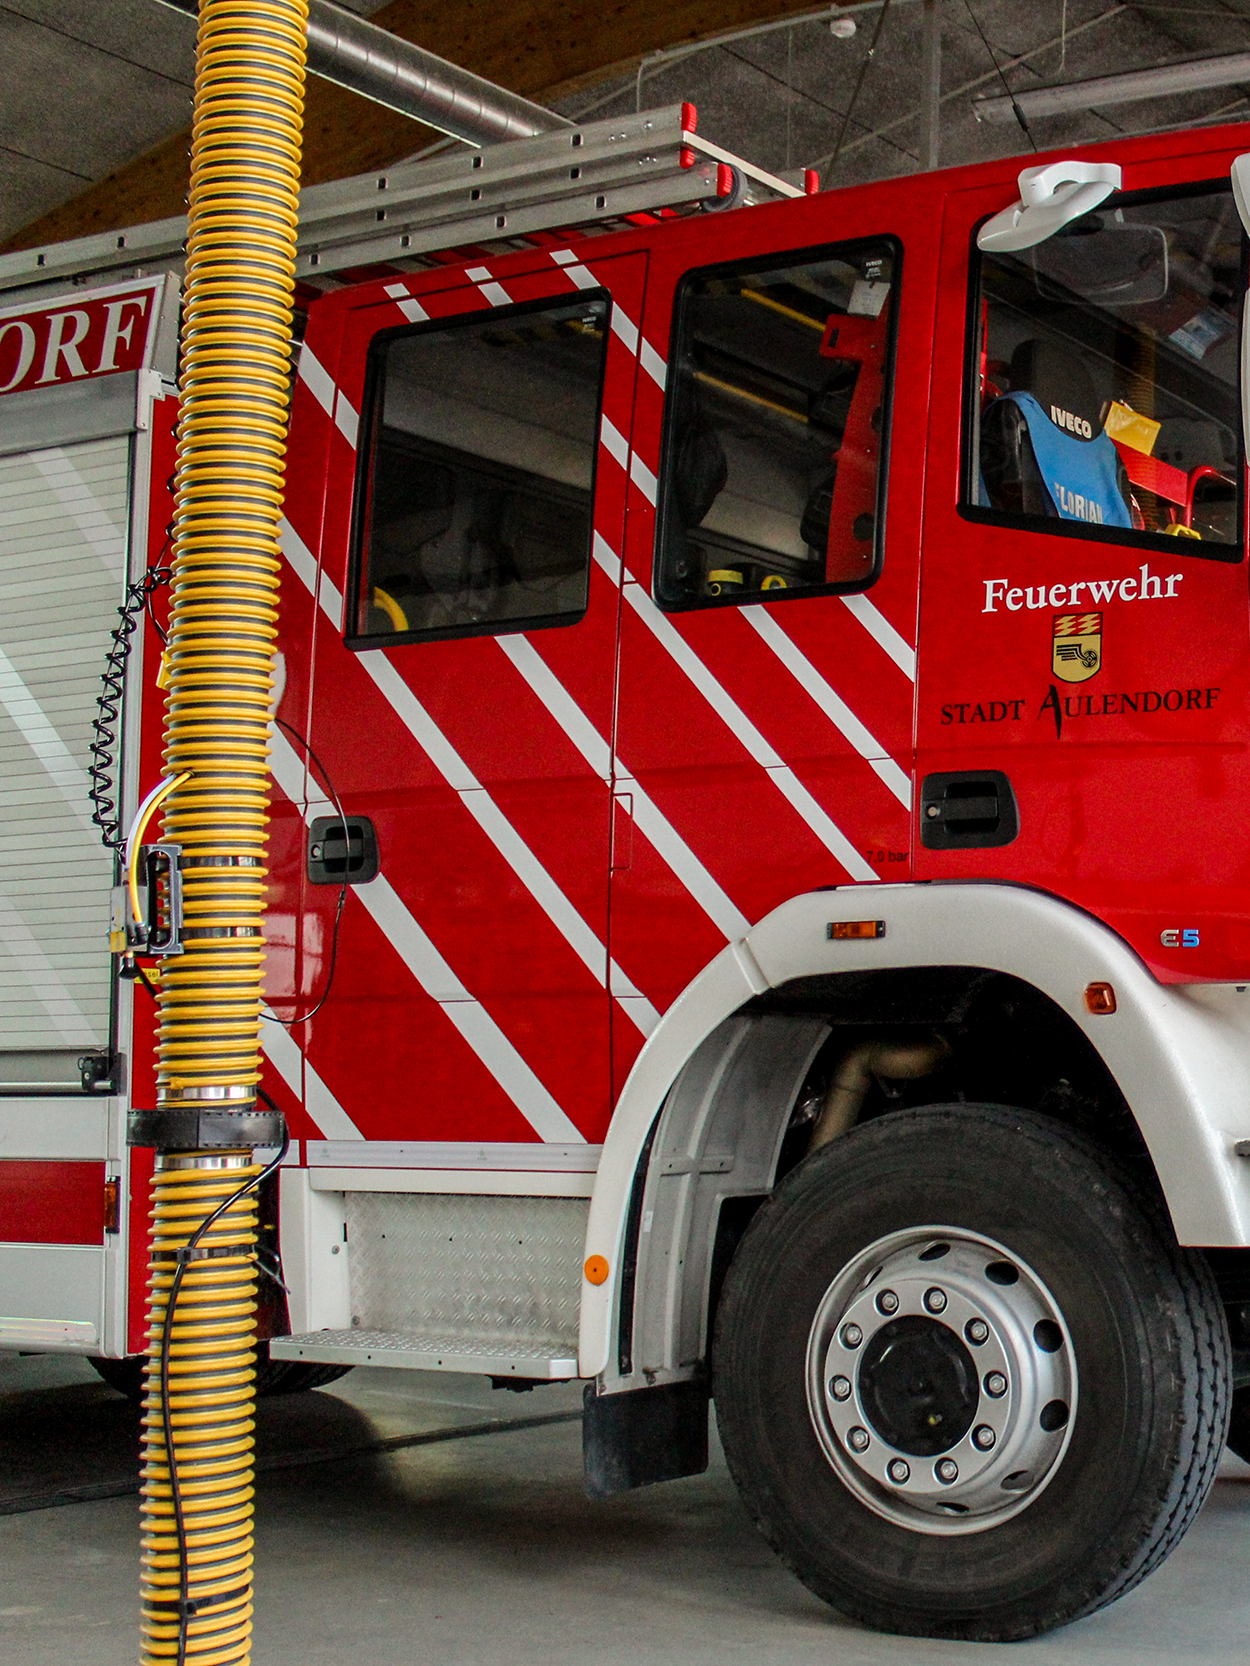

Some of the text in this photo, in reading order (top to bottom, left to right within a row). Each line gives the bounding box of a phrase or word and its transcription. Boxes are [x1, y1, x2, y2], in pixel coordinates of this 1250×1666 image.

[1050, 404, 1092, 439] IVECO
[981, 563, 1184, 613] Feuerwehr
[940, 684, 1221, 740] STADT AULENDORF
[888, 850, 910, 862] bar
[1160, 929, 1200, 948] E5
